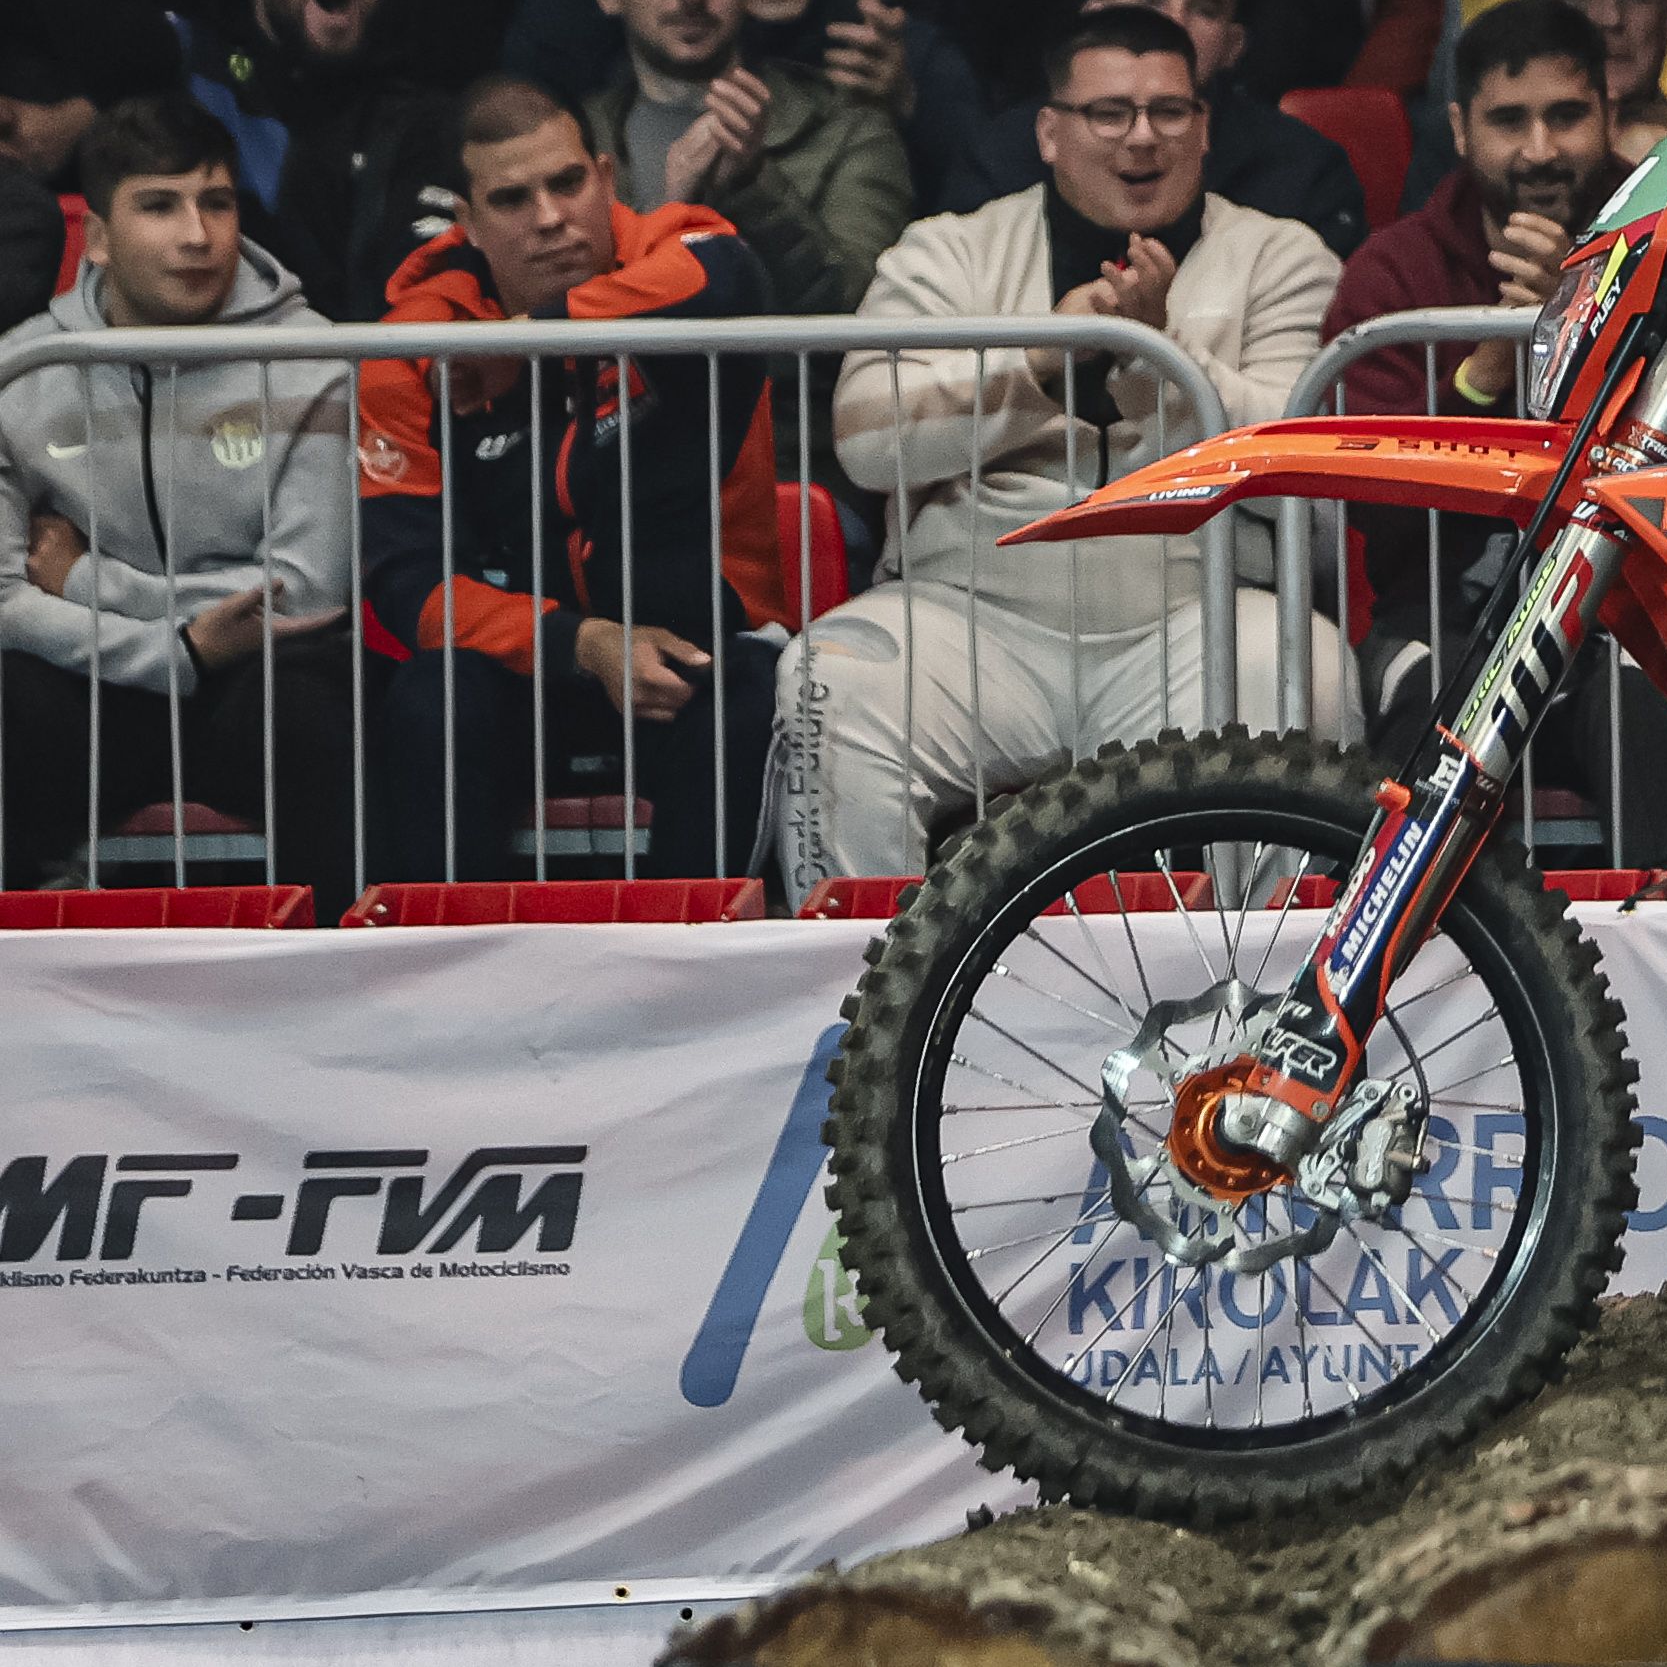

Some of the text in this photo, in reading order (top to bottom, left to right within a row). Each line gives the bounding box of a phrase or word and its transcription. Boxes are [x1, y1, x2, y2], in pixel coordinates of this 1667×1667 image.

[1590, 275, 1622, 338] PUEY
[1341, 821, 1423, 961] MICHELIN
[68, 1268, 207, 1286] Federakuntza
[226, 1264, 335, 1282] Federación
[341, 1262, 404, 1280] Vasca
[410, 1263, 433, 1278] de
[439, 1260, 571, 1279] Motociclismo
[1067, 1247, 1468, 1335] KIROLAK
[1072, 1348, 1222, 1387] UDALA
